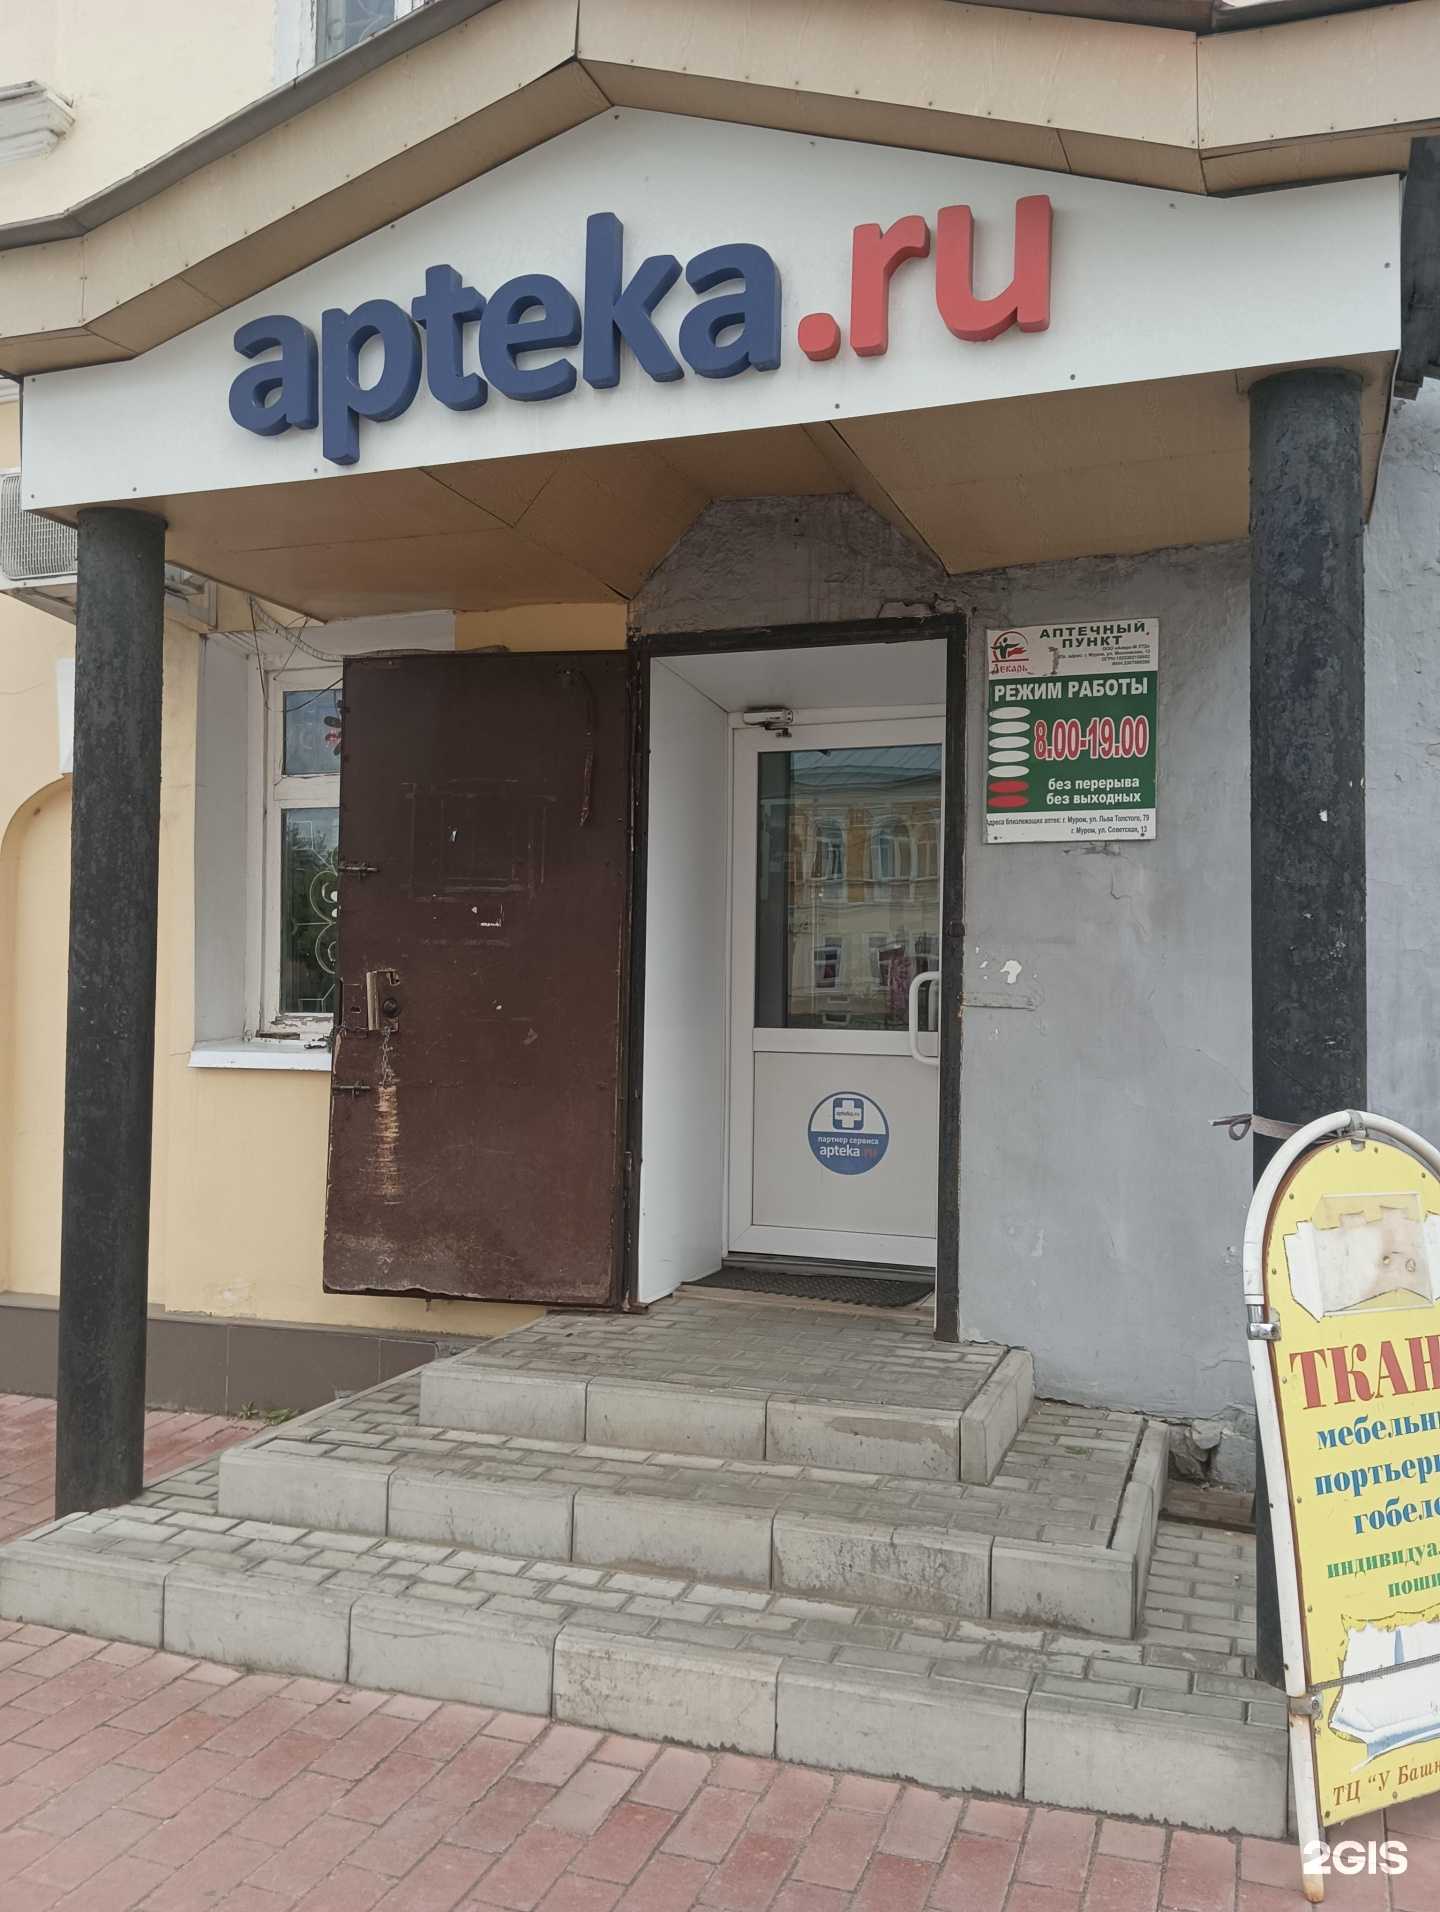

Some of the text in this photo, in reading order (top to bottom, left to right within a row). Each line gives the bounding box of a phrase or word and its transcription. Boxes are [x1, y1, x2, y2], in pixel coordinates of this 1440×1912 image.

[228, 194, 1054, 465] apteka.ru
[1039, 621, 1145, 639] АПТЕЧНЫЙ
[1062, 635, 1123, 649] ПУНКТ
[994, 677, 1148, 702] РЕЖИМ РАБОТЫ
[1033, 715, 1150, 761] 8.00-19.00
[1048, 778, 1140, 793] без перерыва
[1046, 793, 1142, 806] без выходных
[1067, 815, 1089, 824] Муром,
[1316, 1410, 1440, 1450] мебельн
[1326, 1542, 1440, 1579] индивидуа
[1333, 1780, 1361, 1806] ТЦ
